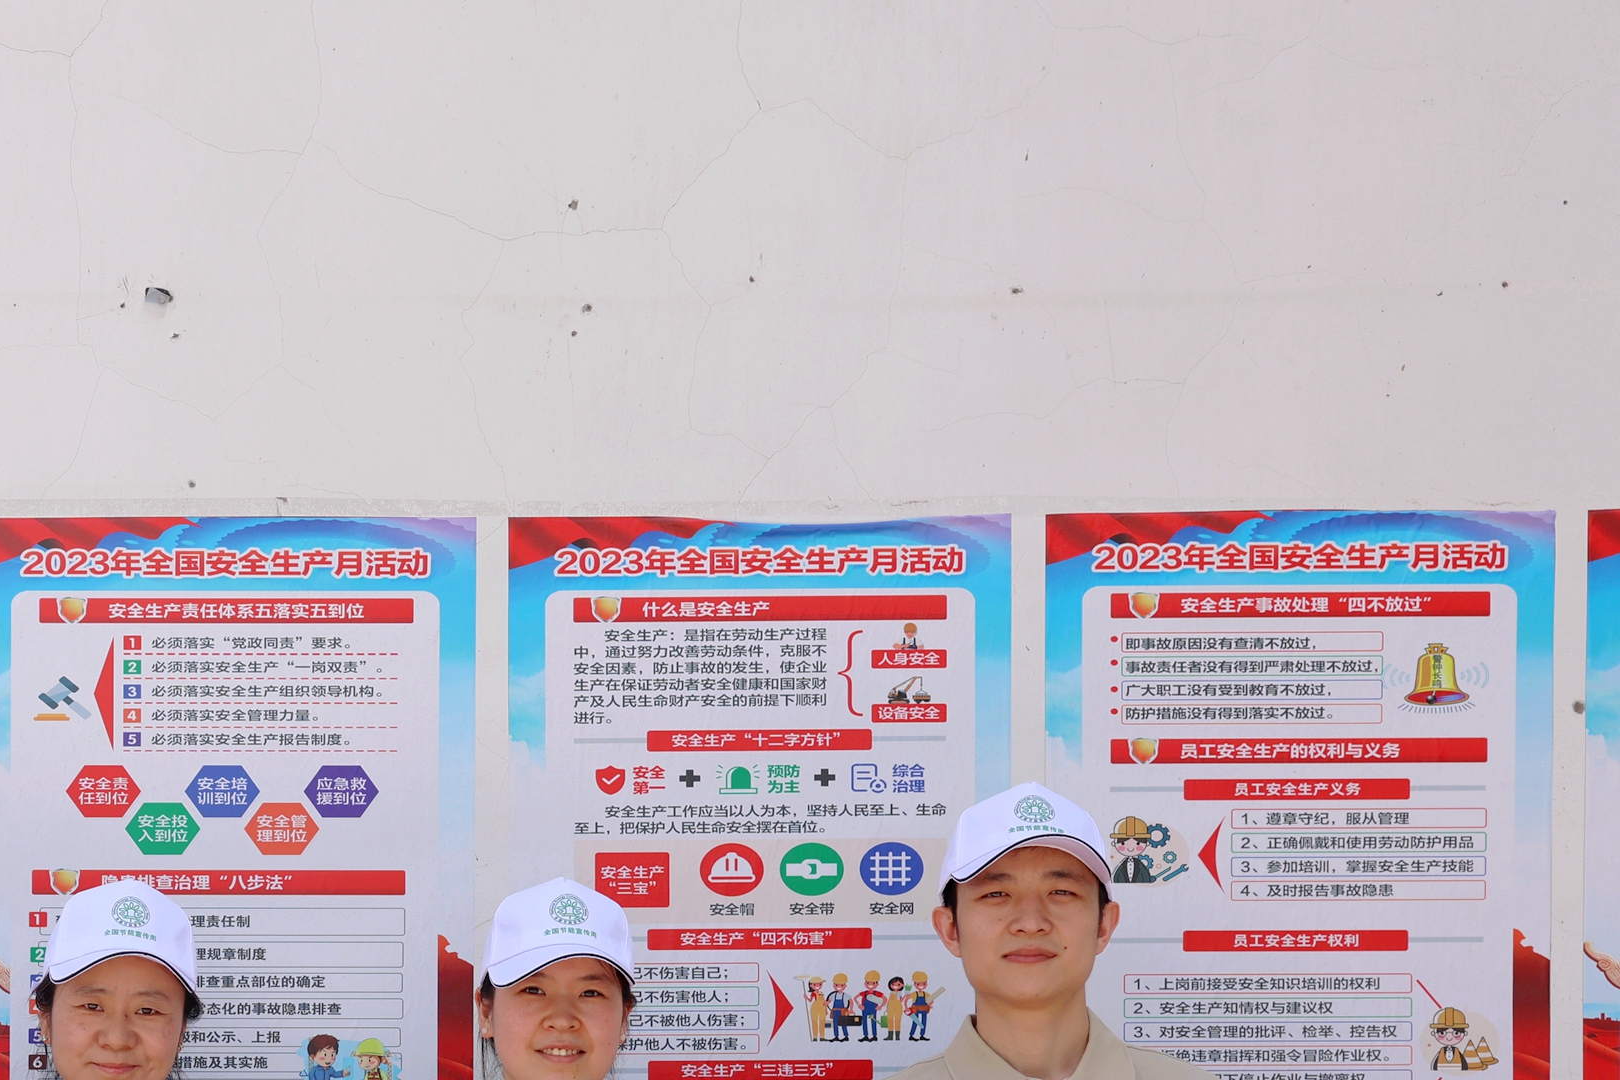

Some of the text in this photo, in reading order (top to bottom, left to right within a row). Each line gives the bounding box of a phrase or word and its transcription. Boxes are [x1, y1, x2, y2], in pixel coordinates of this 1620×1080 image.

[23, 550, 429, 577] 2023年全国安全生产月活动
[557, 548, 963, 575] 2023年全国安全生产月活动
[1094, 544, 1505, 571] 2023年全国安全生产月活动
[108, 603, 365, 619] 安全生产责任体系五落实五到位
[642, 602, 769, 617] 什么是安全生产
[1181, 597, 1431, 613] 安全生产事故处理“四不放过”
[604, 628, 827, 642] 安全生产：是指在劳动生产过程
[878, 652, 940, 666] 人身安全
[152, 684, 383, 698] 必须落实安全生产组织领导机构。
[574, 677, 827, 691] 生产在保证劳动者安全健康和国家财
[574, 693, 827, 708] 产及人民生命财产安全的前提下顺利
[152, 709, 320, 722] 必须落实安全管理力量。
[574, 711, 613, 725] 进行。
[878, 706, 940, 720] 设备安全
[152, 732, 352, 746] 必须落实安全生产报告制度。
[671, 733, 840, 747] 安全生产“十二字方针”
[1180, 744, 1401, 760] 员工安全生产的权利与义务
[633, 765, 665, 780] 安全
[767, 765, 800, 779] 预防
[892, 765, 925, 779] 综合
[79, 777, 128, 791] 安全责
[197, 777, 248, 791] 安全培
[316, 777, 366, 791] 应急救
[633, 780, 665, 795] 第一
[767, 780, 800, 794] 为主
[892, 780, 925, 793] 治理
[1234, 783, 1360, 797] 员工安全生产义务
[78, 792, 128, 806] 任到位
[197, 792, 248, 806] 训到位
[316, 792, 366, 806] 援到位
[138, 814, 188, 828] 安全投
[257, 814, 307, 828] 安全管
[138, 829, 188, 843] 入到位
[257, 829, 307, 843] 理到位
[1240, 836, 1474, 850] 2、正确佩戴和使用劳动防护用品
[600, 865, 664, 879] 安全生产
[609, 881, 656, 895] “三宝”
[1240, 883, 1393, 898] 4、及时报告事故隐患
[709, 902, 755, 916] 安全帽
[789, 902, 835, 915] 安全带
[869, 901, 914, 915] 安全网
[104, 929, 156, 942] 全国节能宣传周
[544, 927, 597, 938] 全国节能宣传周
[680, 930, 832, 945] 安全生产“四不伤害”
[1233, 933, 1360, 949] 员工安全生产权利
[1133, 977, 1380, 992] 1、上岗前接受安全知识培训的权利
[1133, 1001, 1333, 1016] 2、安全生产知情权与建议权
[1133, 1024, 1397, 1039] 3、对安全管理的批评、检举、控告权
[681, 1063, 833, 1077] 安全生产“三违三无”
